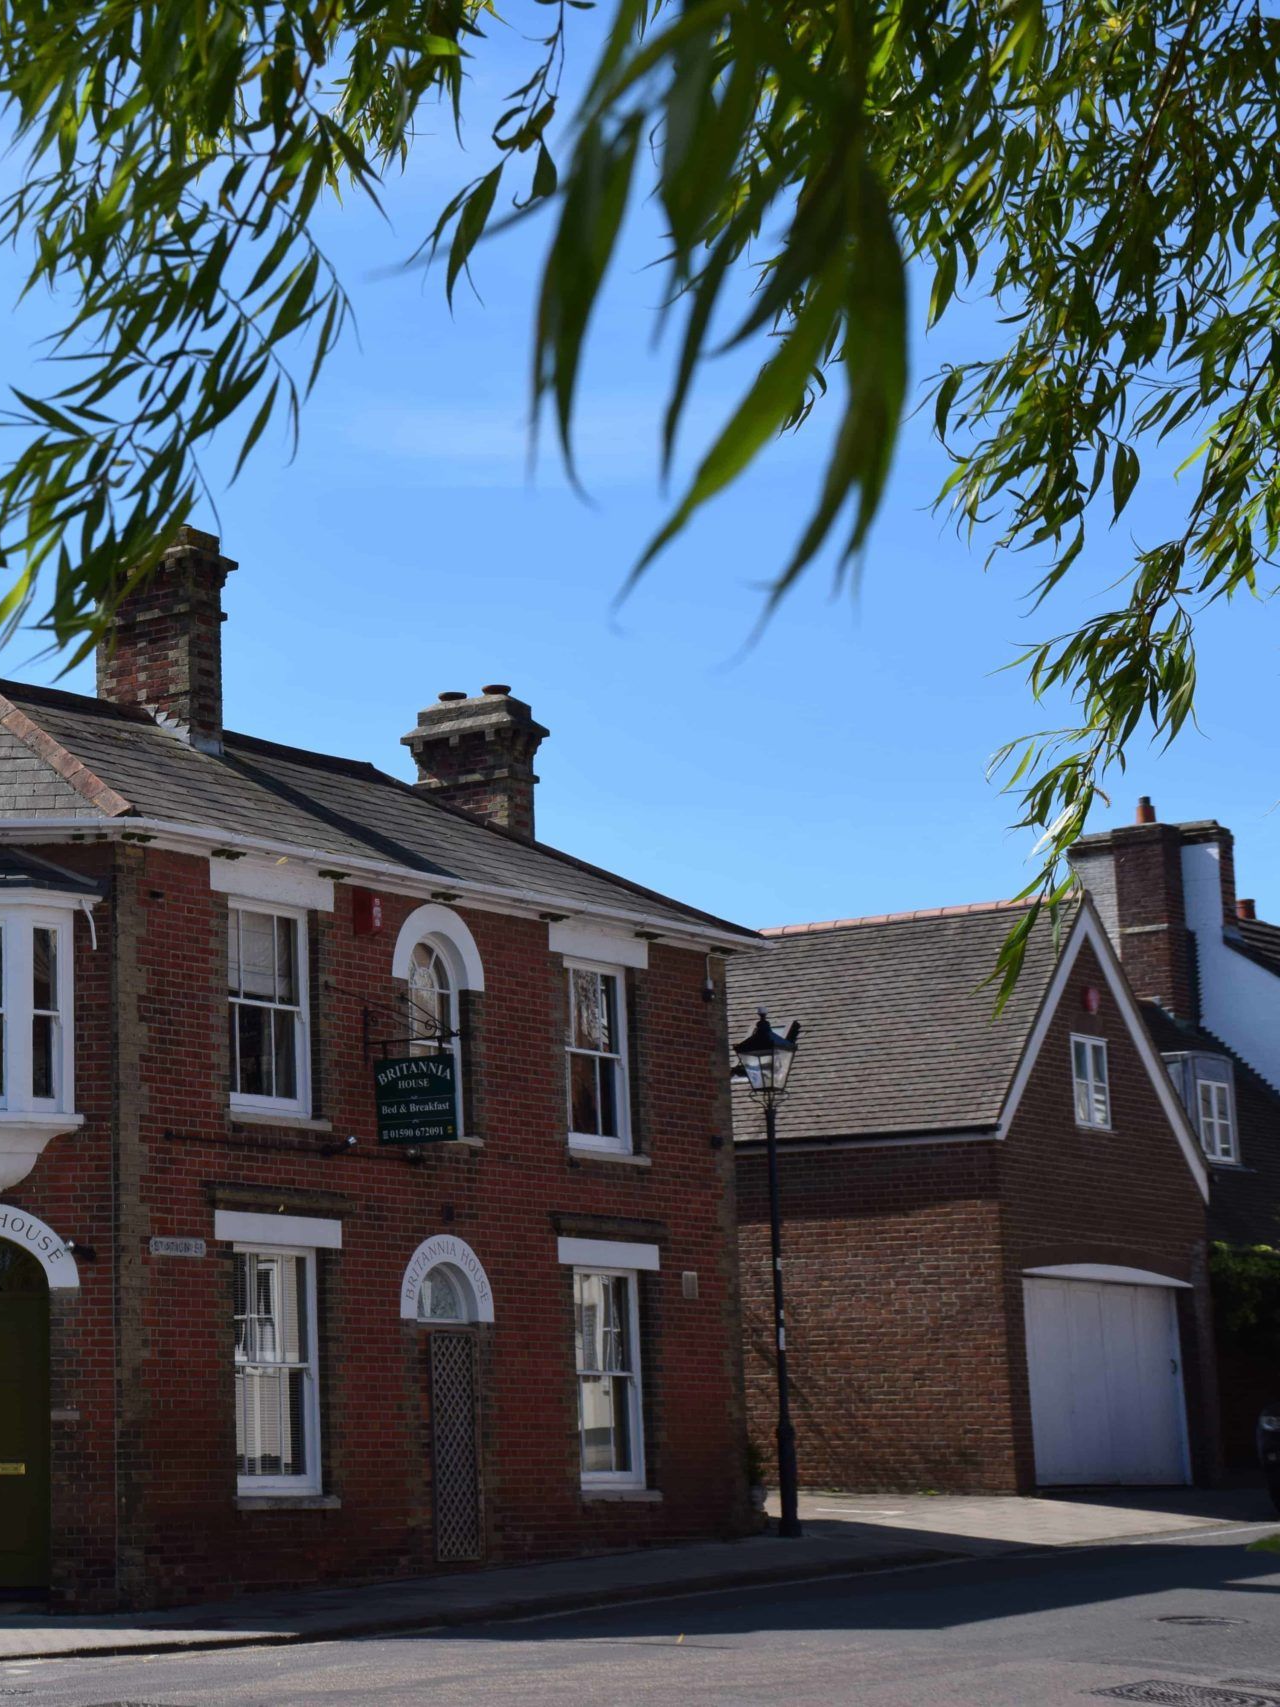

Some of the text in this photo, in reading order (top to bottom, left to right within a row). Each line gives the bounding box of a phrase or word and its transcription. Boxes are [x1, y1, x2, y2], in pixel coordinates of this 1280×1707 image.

[378, 1061, 451, 1086] BRITANNIA
[398, 1079, 430, 1089] HOUSE
[382, 1101, 449, 1115] Bed & Breakfast
[390, 1129, 414, 1139] 01590
[415, 1126, 443, 1137] 672091
[405, 1240, 489, 1304] BRITANNIA HOUSE
